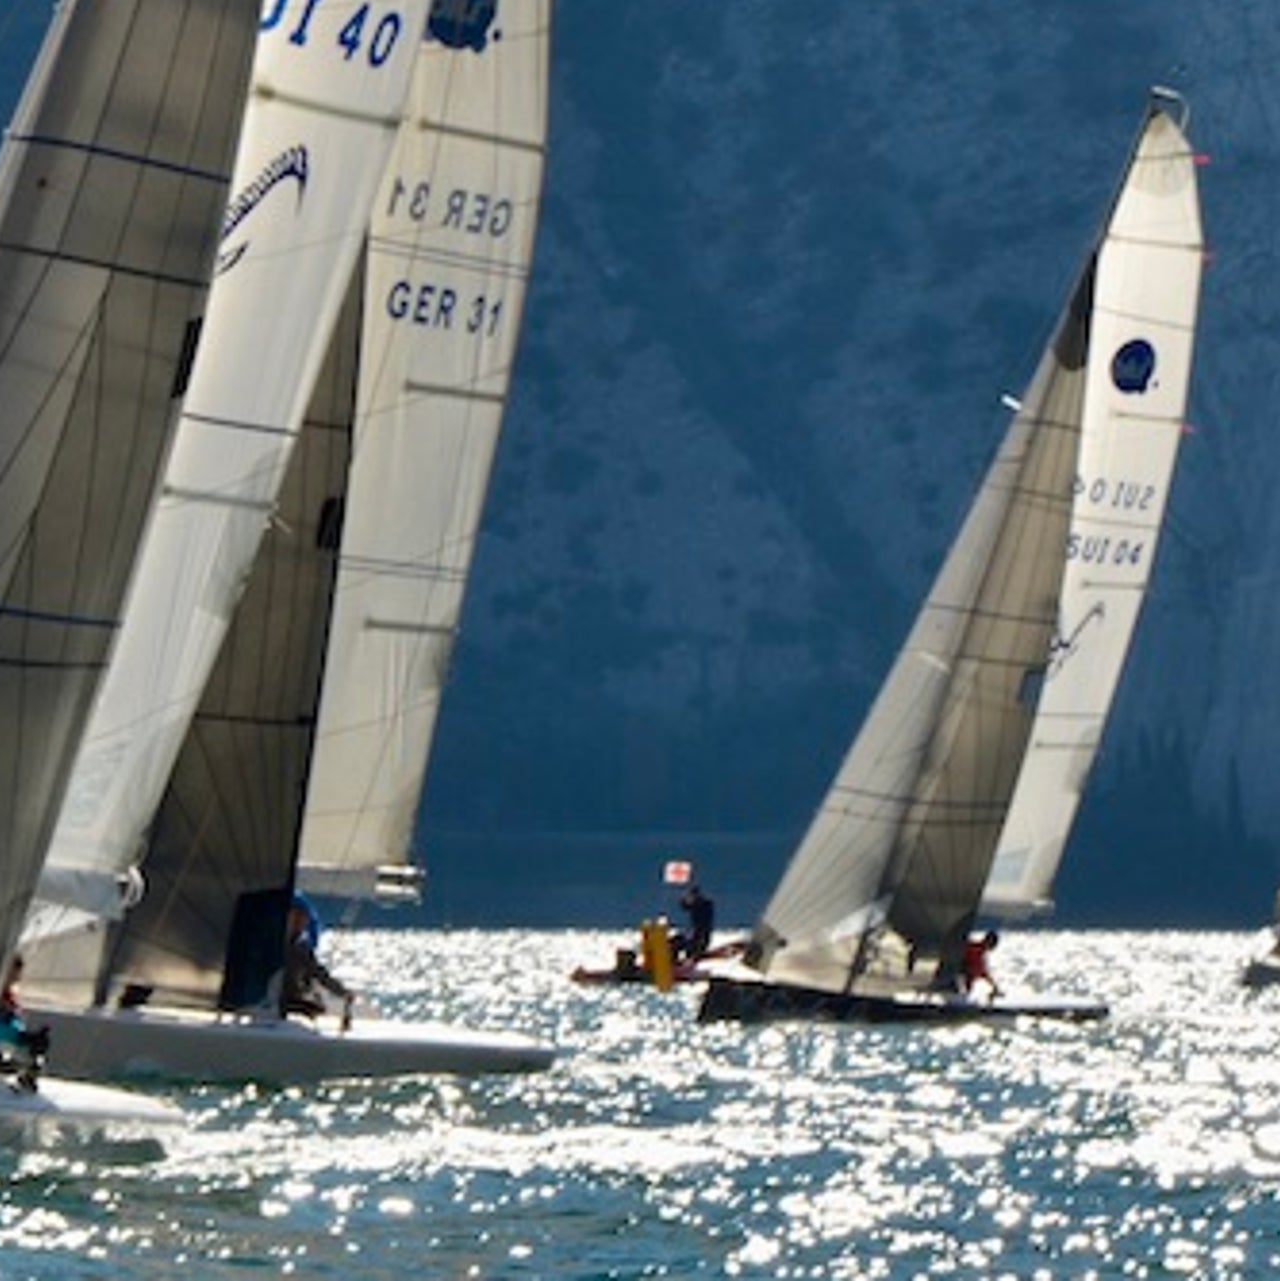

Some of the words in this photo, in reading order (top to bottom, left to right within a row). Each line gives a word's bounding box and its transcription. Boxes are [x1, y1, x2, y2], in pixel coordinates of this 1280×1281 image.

[339, 2, 401, 67] 40
[386, 281, 457, 329] GER
[467, 296, 502, 337] 31
[1066, 535, 1110, 564] SUI
